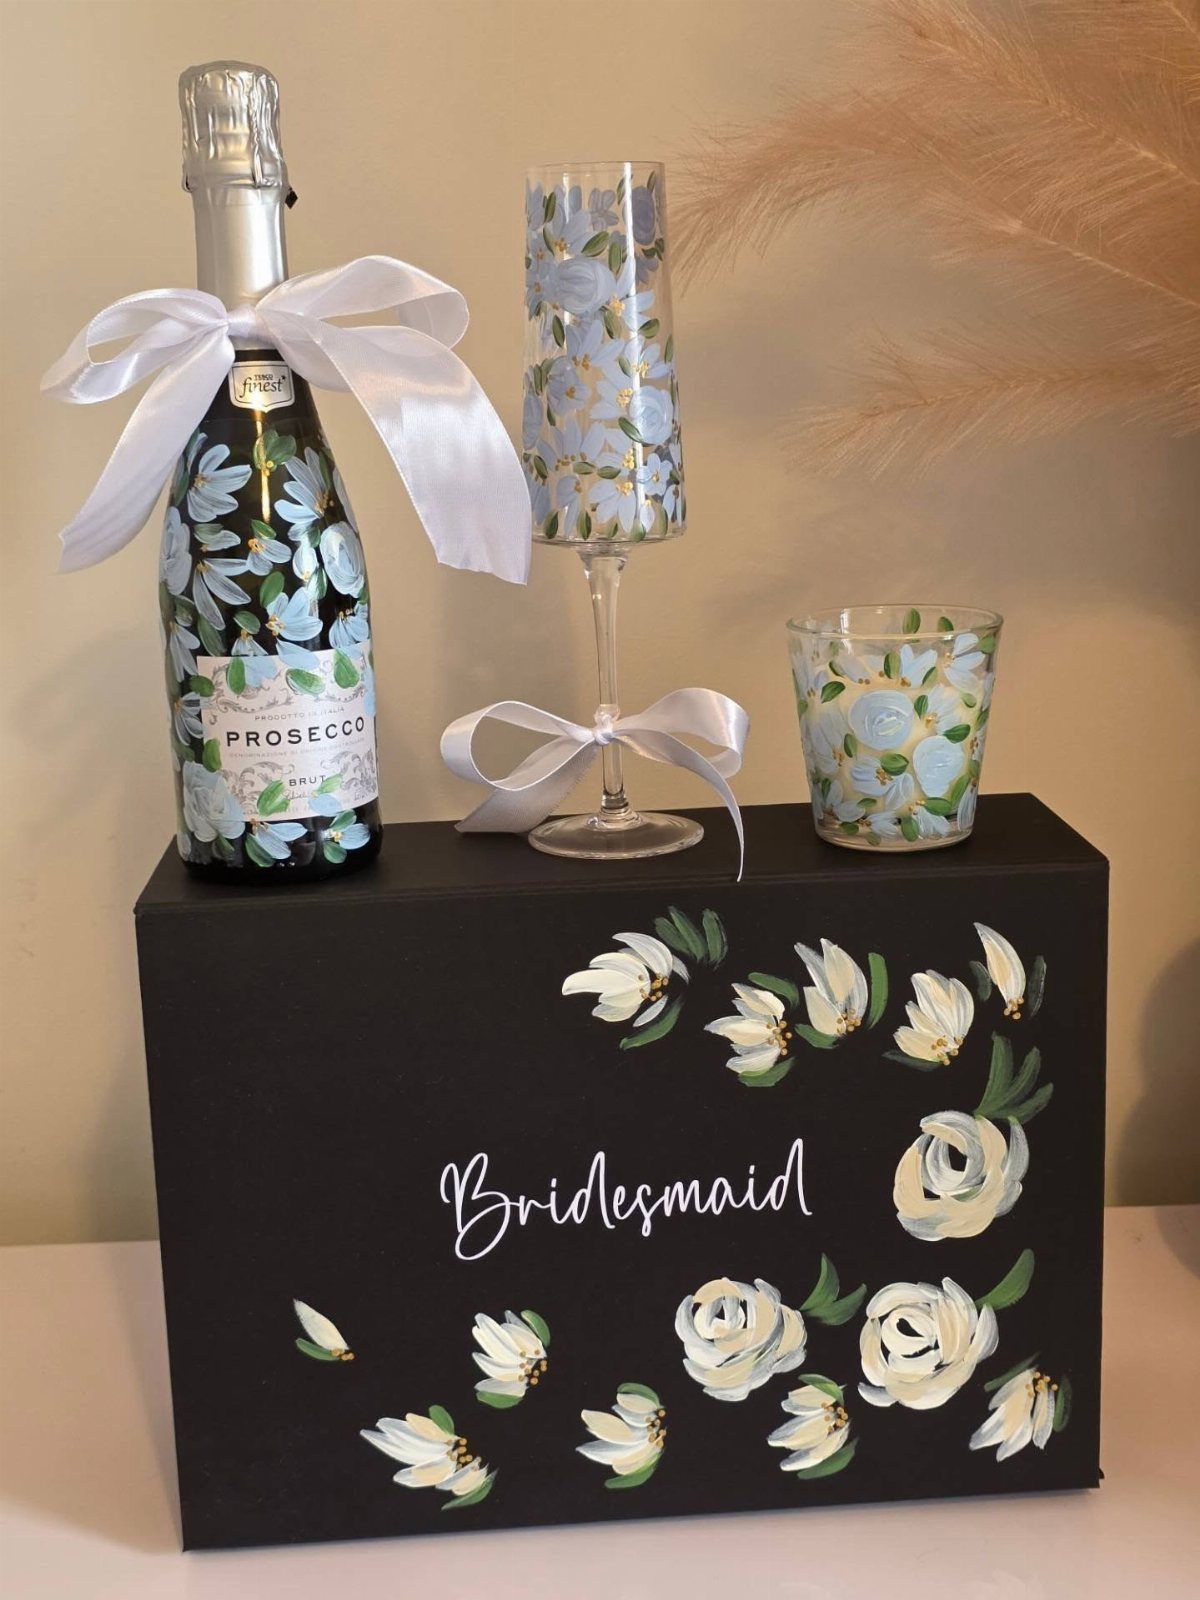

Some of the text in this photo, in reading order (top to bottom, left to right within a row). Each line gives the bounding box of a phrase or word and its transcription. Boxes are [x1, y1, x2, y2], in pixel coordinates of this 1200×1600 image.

[239, 376, 283, 398] finest
[254, 712, 305, 721] PRODOTTO
[226, 716, 365, 748] PROSECCO
[288, 774, 326, 787] BRUT
[439, 1137, 813, 1261] Bridesmaid
